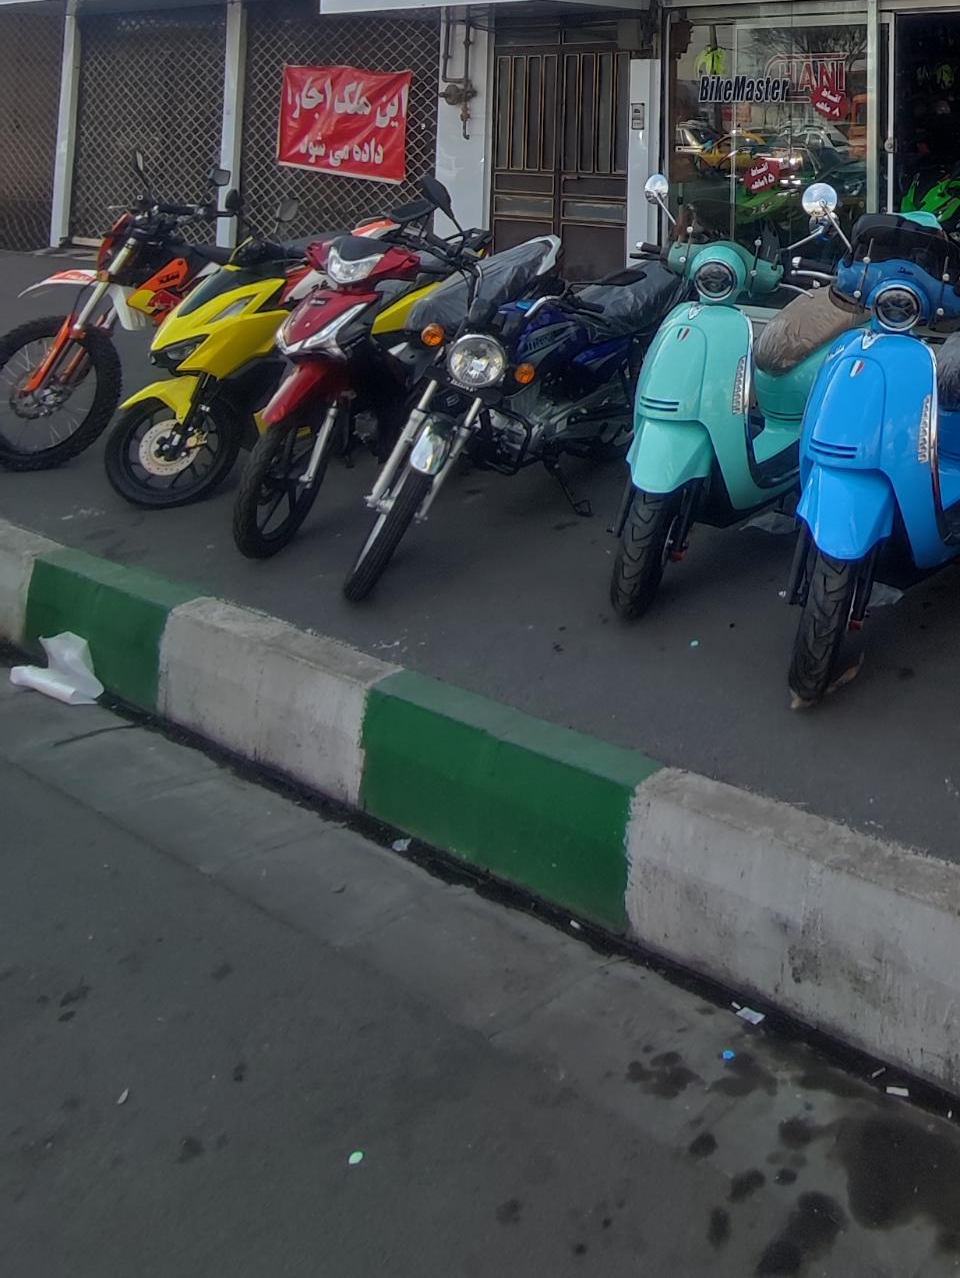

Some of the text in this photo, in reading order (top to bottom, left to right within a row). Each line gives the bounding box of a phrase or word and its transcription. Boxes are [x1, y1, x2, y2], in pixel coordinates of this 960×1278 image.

[335, 81, 372, 115] ملک
[699, 74, 789, 103] BikeMaster
[375, 83, 409, 128] این
[353, 138, 384, 164] داده
